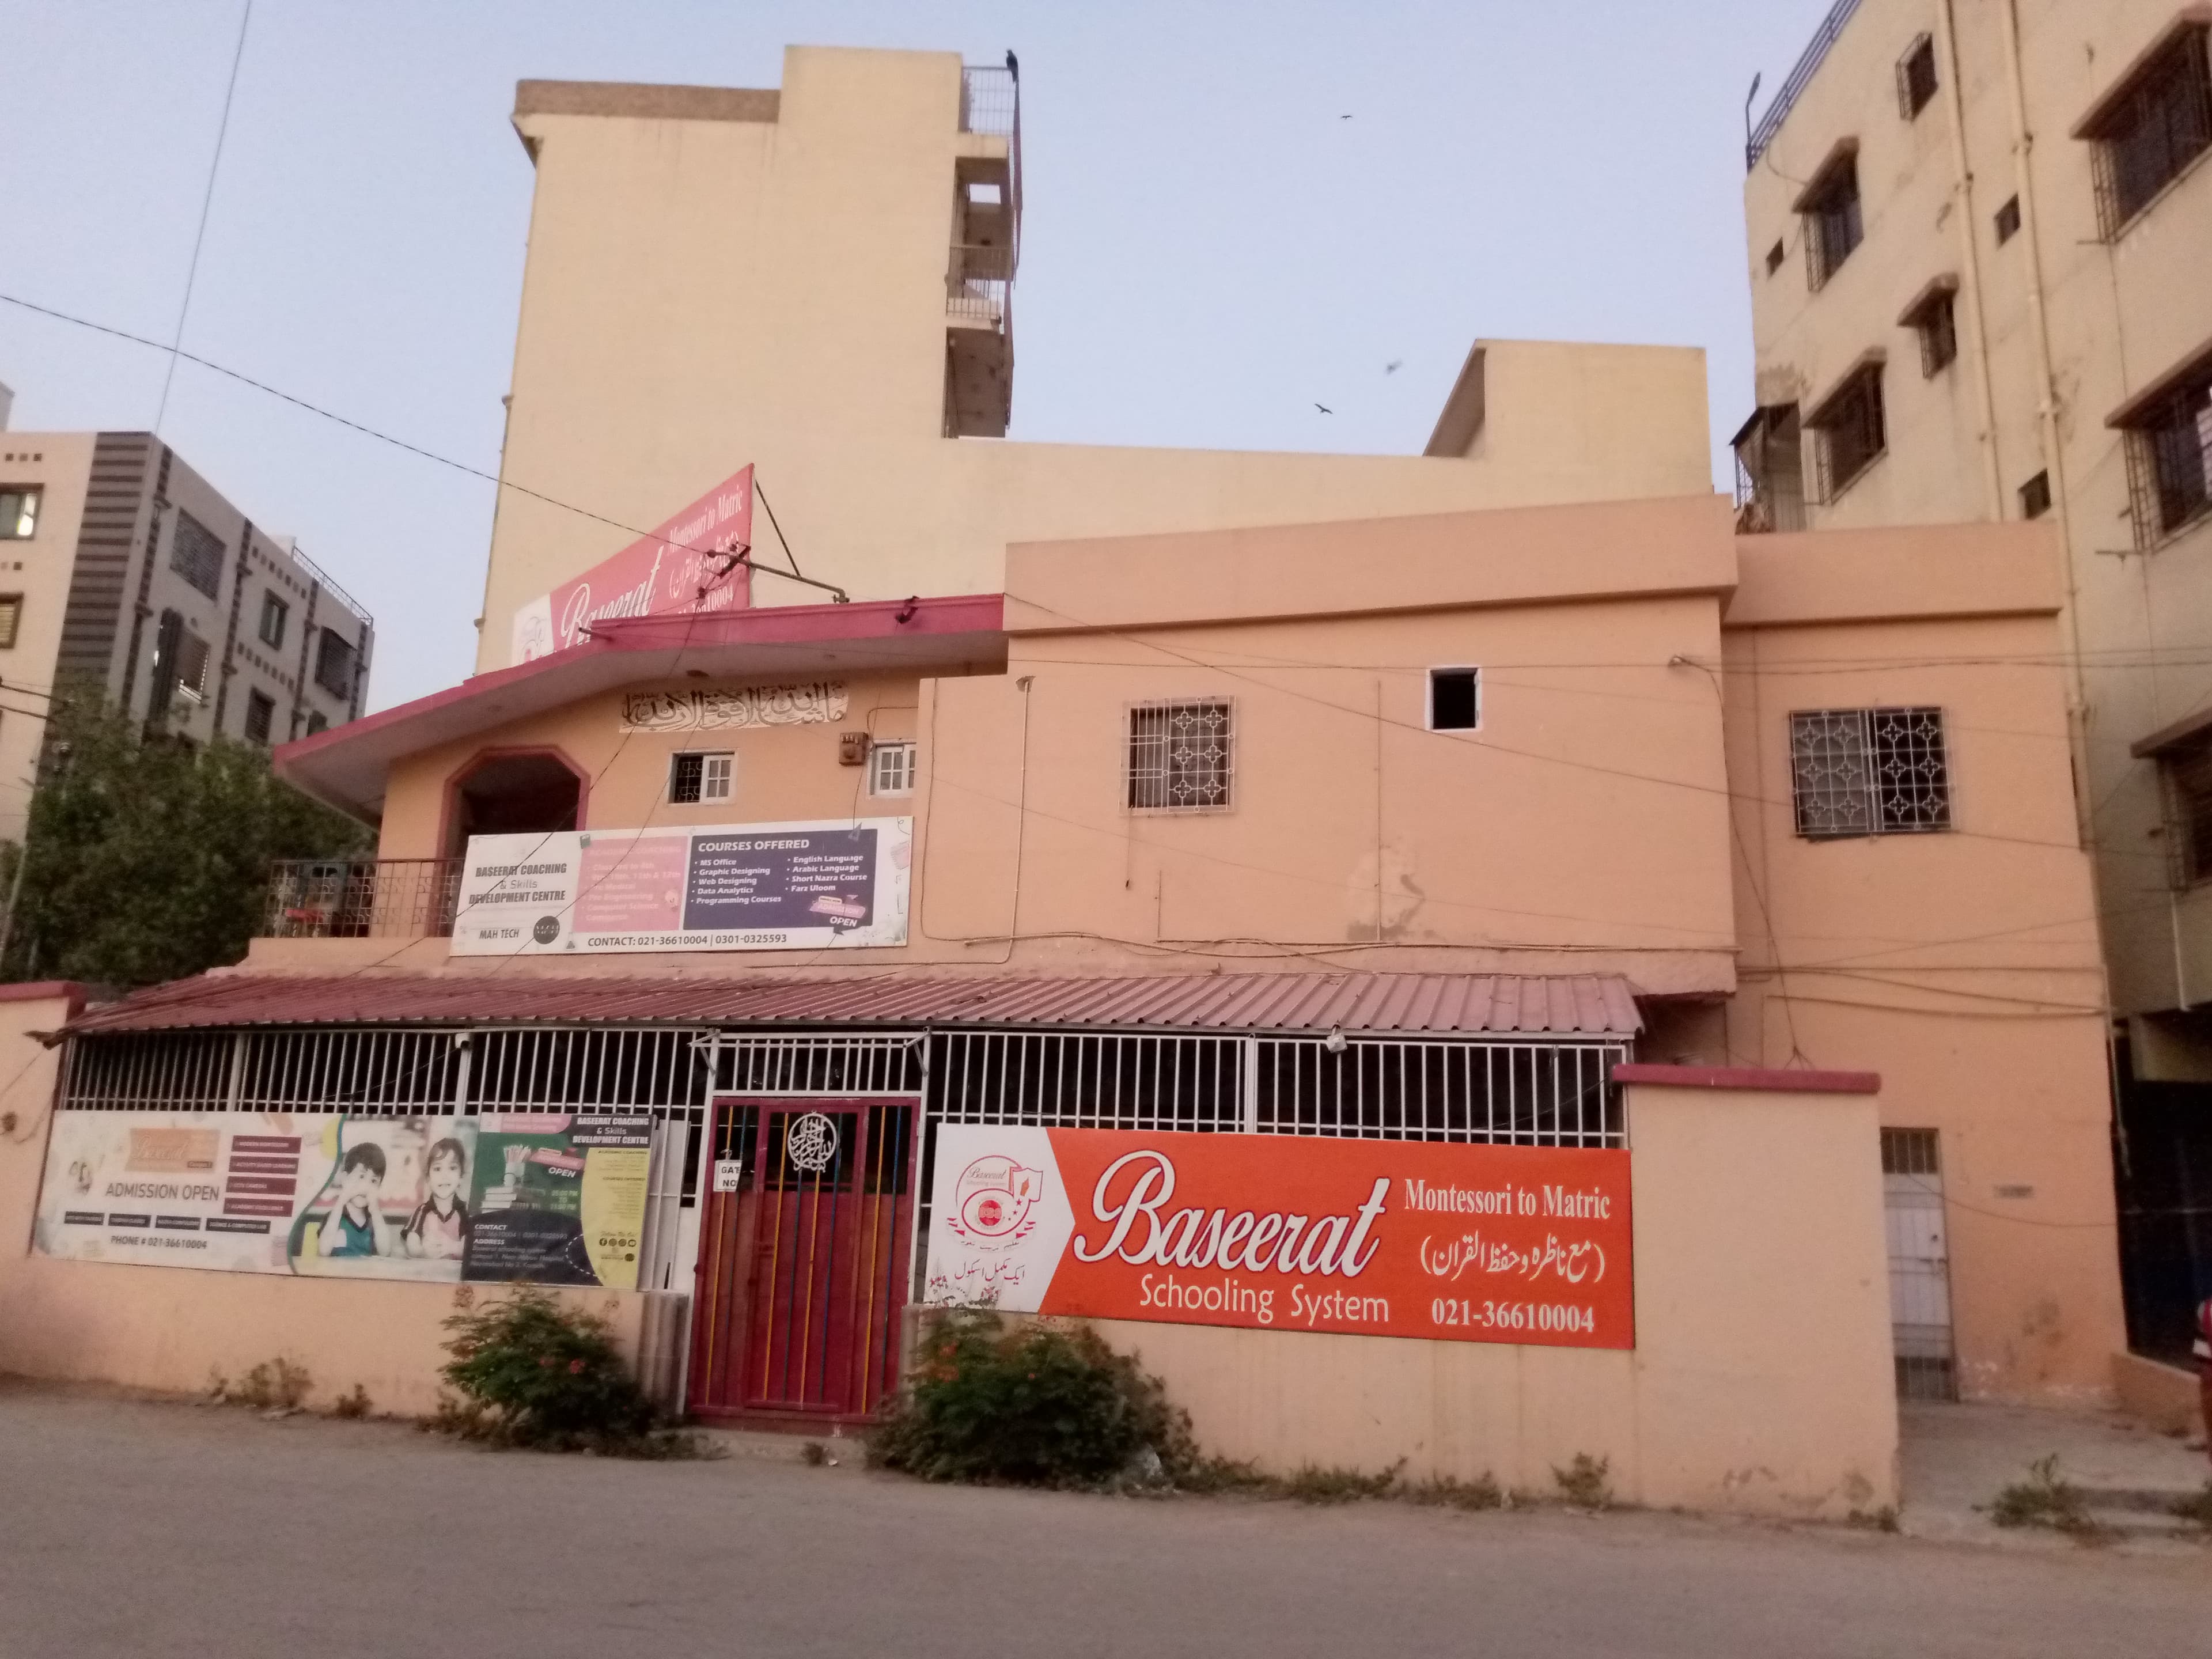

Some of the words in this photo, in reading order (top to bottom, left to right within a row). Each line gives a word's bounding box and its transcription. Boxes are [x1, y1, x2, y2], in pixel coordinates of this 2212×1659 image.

[698, 841, 752, 852] COURSES
[754, 839, 810, 850] OFFERED
[793, 856, 823, 865] English
[824, 855, 863, 863] Language
[475, 865, 519, 877] BASEERAT
[521, 863, 567, 875] COACHING
[699, 868, 729, 877] Graphic
[730, 867, 771, 876] Designing
[820, 865, 859, 873] Language
[500, 880, 506, 889] &
[511, 880, 537, 889] Skills
[718, 877, 757, 885] Designing
[717, 887, 753, 895] Analytics
[469, 892, 531, 904] DEVELOPMENT
[532, 890, 565, 901] CENTRE
[696, 897, 749, 906] Programming
[830, 916, 858, 927] OPEN
[479, 929, 498, 939] MAH
[500, 928, 519, 938] TECH
[588, 937, 636, 946] CONTACT:
[638, 935, 708, 945] 021-36610004
[715, 934, 787, 944] 0301-0325593
[612, 1118, 649, 1126] COACHING
[605, 1127, 627, 1135] Skills
[573, 1136, 621, 1144] DEVELOPMENT
[622, 1136, 649, 1145] CENTRE
[548, 1167, 576, 1177] OPEN
[105, 1183, 178, 1200] ADMISSION
[182, 1185, 219, 1201] OPEN
[1404, 1179, 1512, 1215] Montessori
[1518, 1187, 1536, 1215] to
[1543, 1185, 1611, 1219] Matric
[1074, 1149, 1391, 1277] Baseerat
[111, 1236, 139, 1245] PHONE
[1139, 1274, 1274, 1324] Schooling
[1291, 1284, 1389, 1326] System
[1431, 1298, 1595, 1332] 021-36610004
